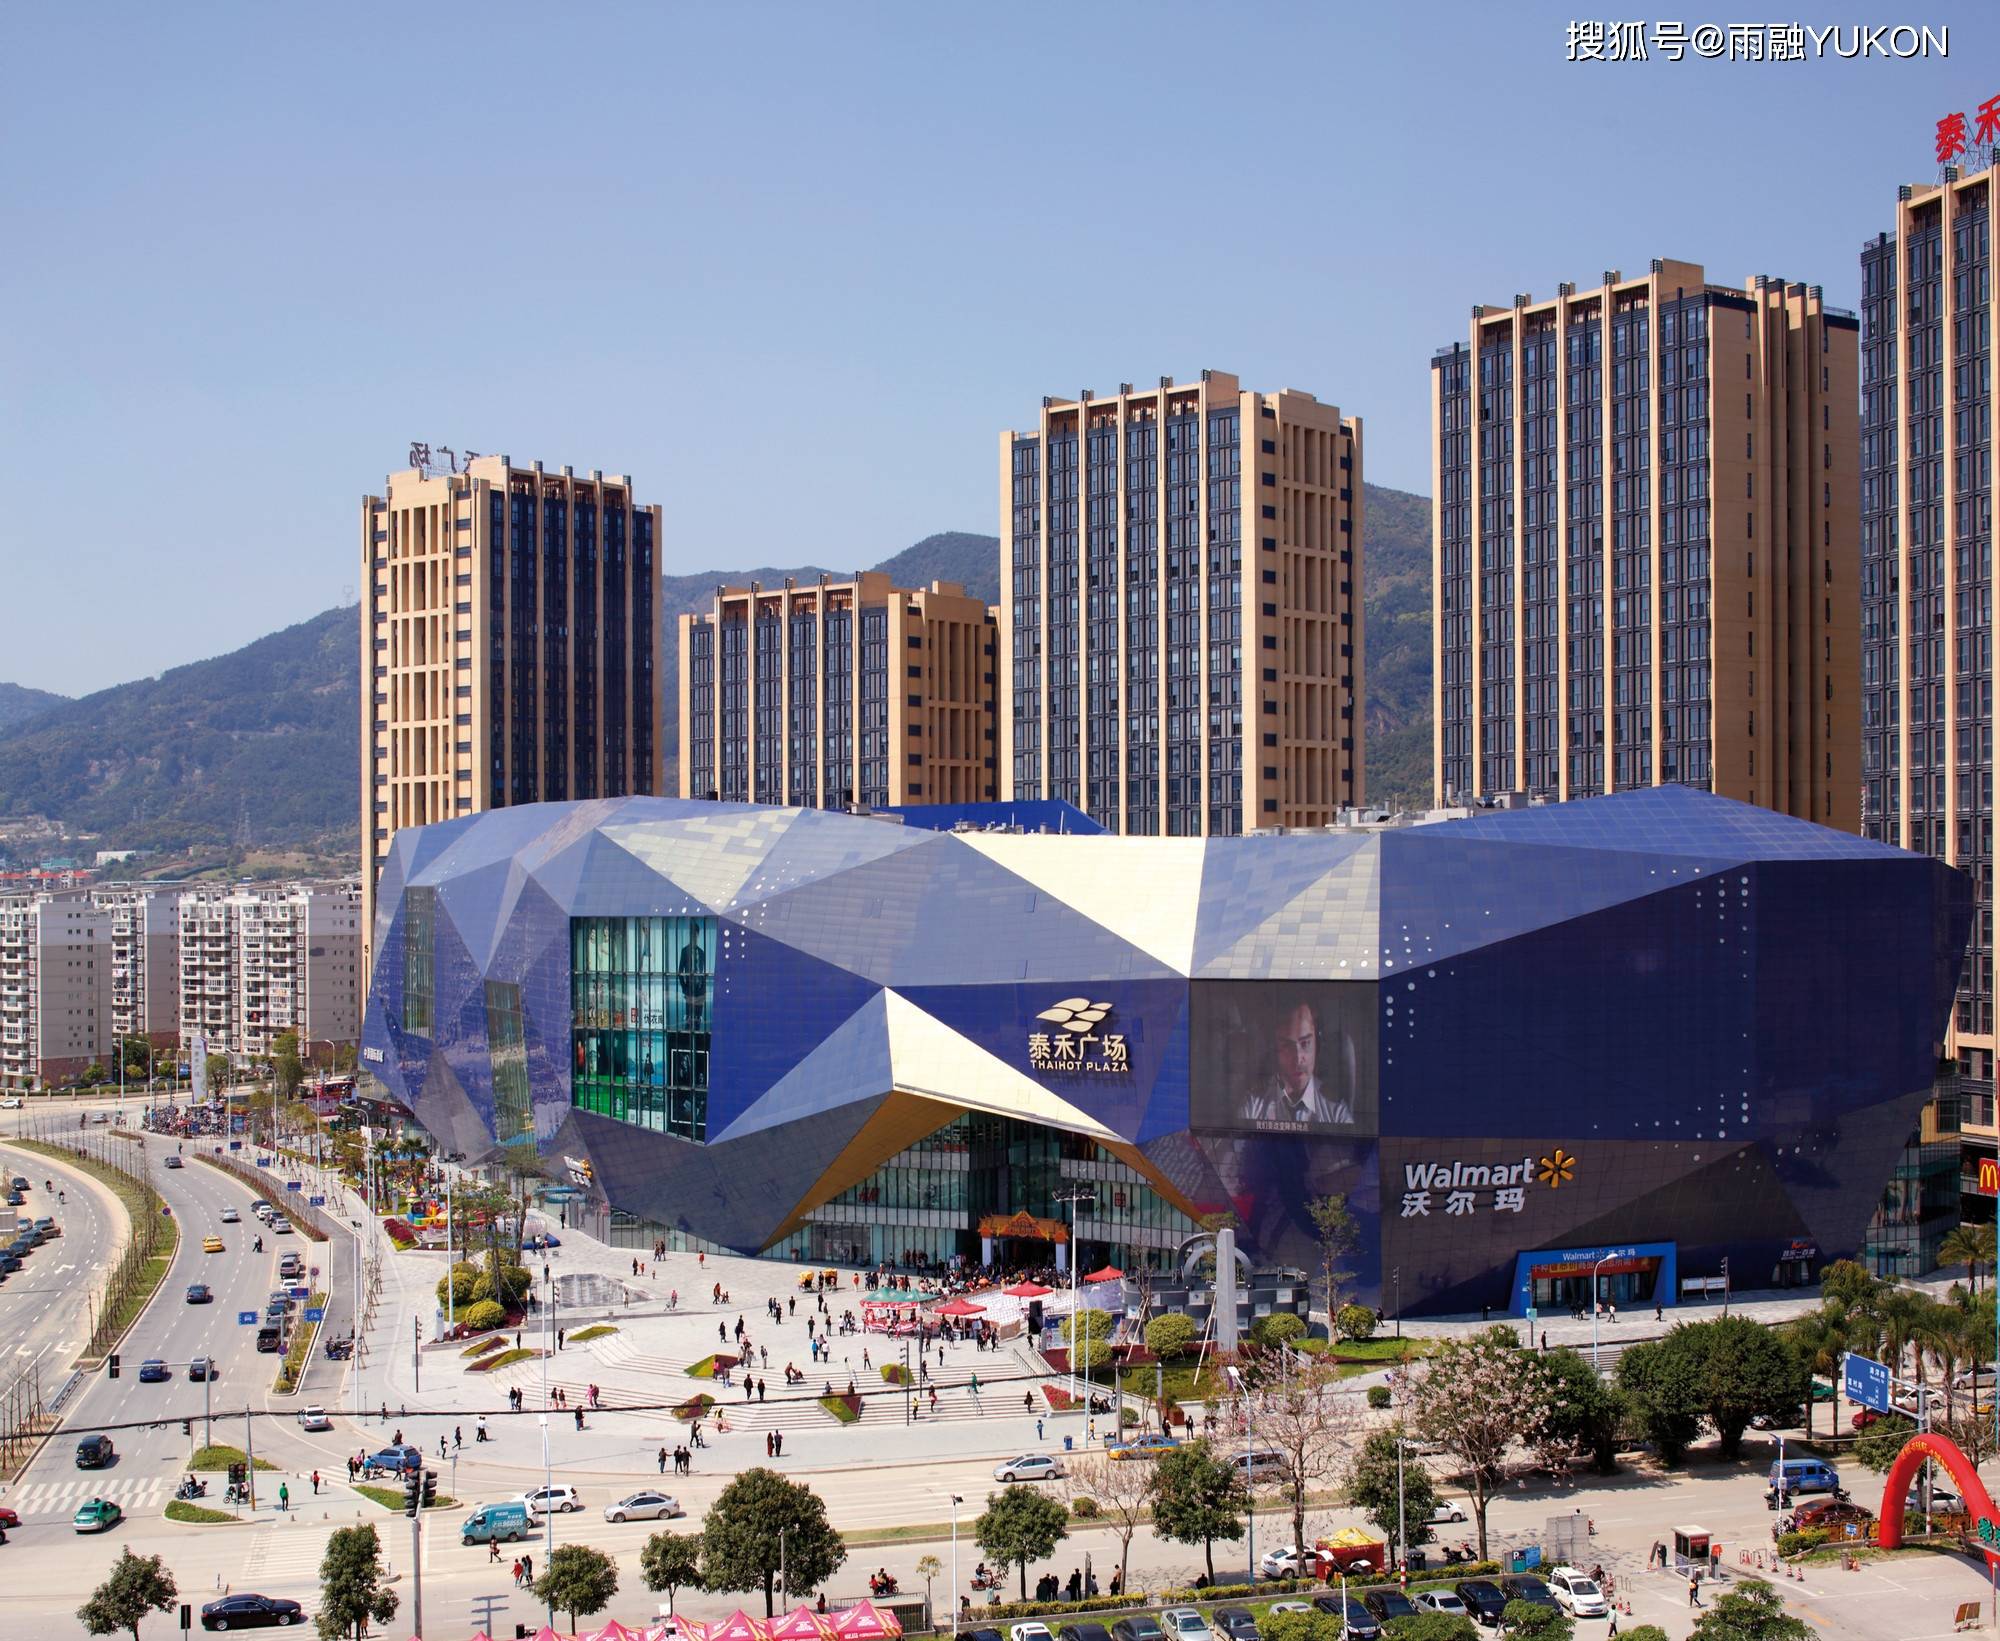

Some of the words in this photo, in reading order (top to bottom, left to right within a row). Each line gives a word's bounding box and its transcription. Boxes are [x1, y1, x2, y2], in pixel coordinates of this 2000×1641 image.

[1028, 1032, 1128, 1062] 泰禾广场
[1030, 1060, 1082, 1071] THAIHOT
[1086, 1062, 1129, 1072] PLAZA
[1405, 1158, 1535, 1190] Walmart
[1401, 1187, 1526, 1218] 沃尔玛
[1562, 1251, 1596, 1261] Walmart
